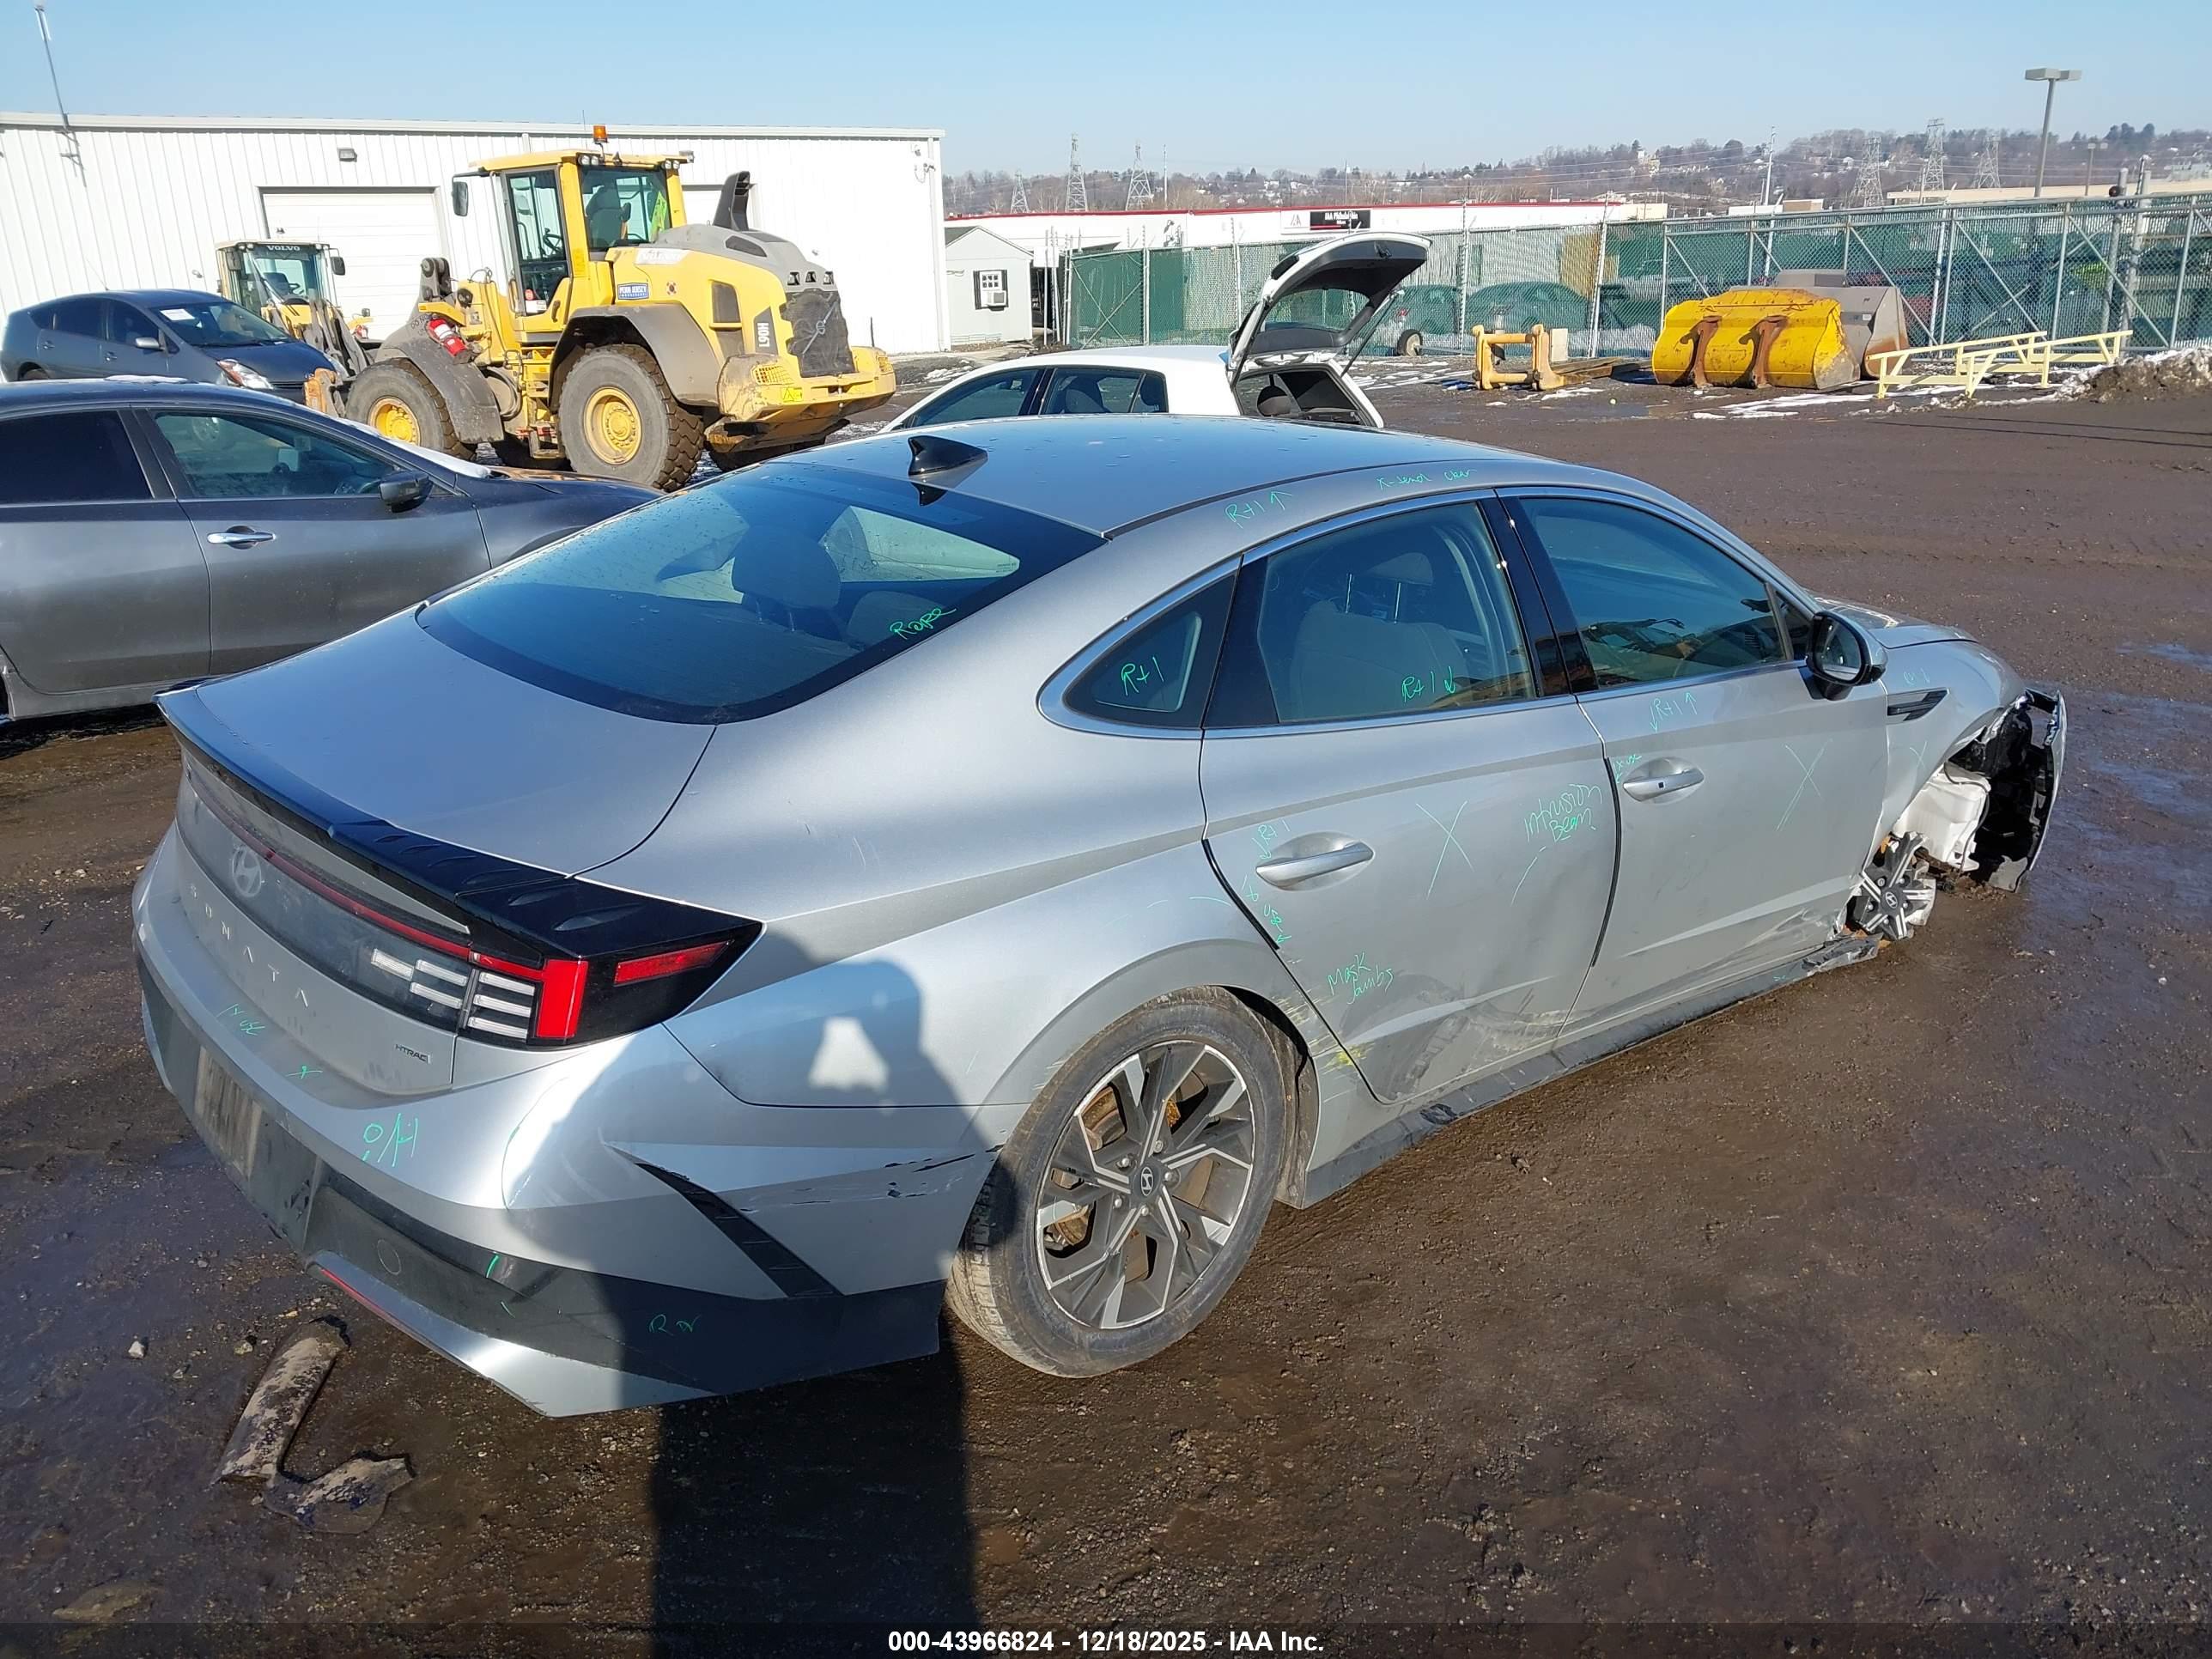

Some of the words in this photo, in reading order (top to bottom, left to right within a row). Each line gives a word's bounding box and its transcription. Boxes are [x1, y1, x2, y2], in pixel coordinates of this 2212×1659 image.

[757, 322, 770, 347] L90H
[190, 884, 309, 1008] SONATA
[393, 1042, 430, 1065] HTRAC
